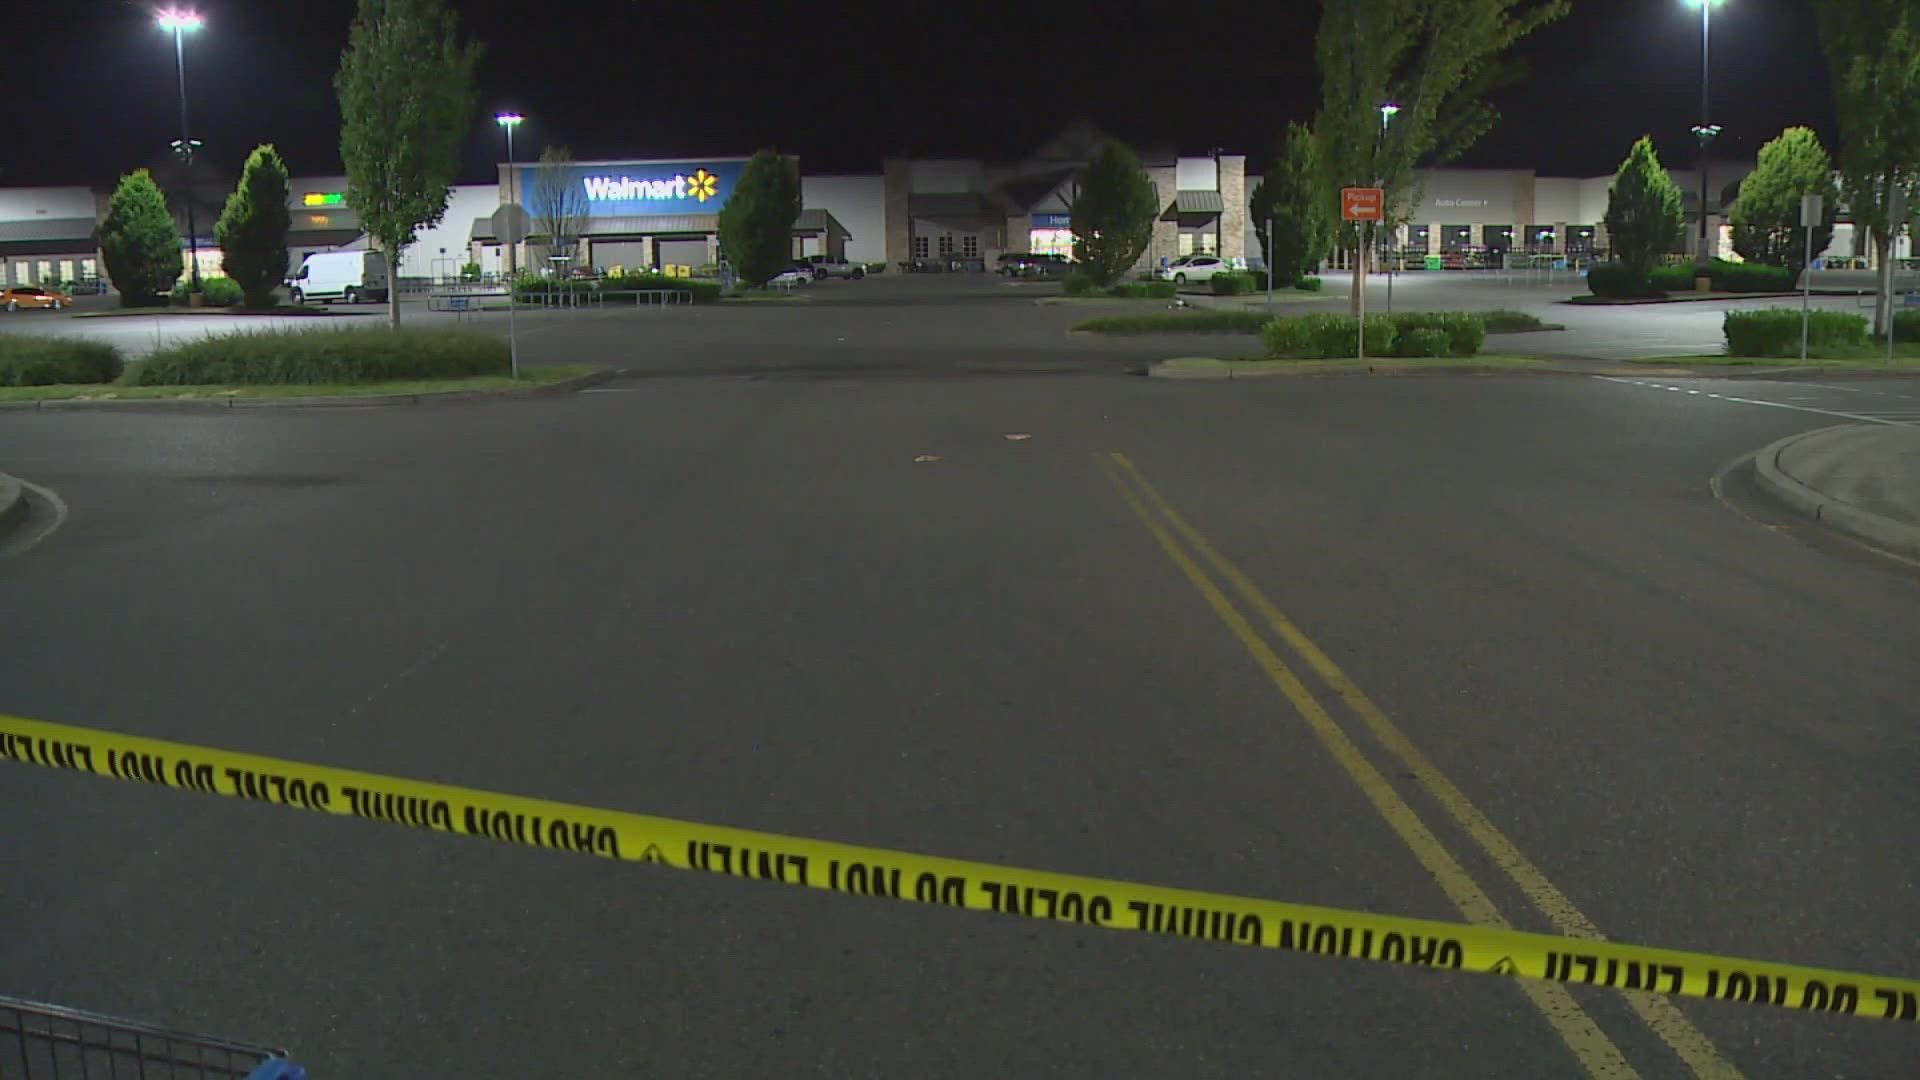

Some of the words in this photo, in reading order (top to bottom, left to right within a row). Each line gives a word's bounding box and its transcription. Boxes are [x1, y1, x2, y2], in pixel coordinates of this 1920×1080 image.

[583, 175, 687, 200] Walmart
[1347, 191, 1377, 204] Pickup
[1435, 198, 1455, 208] Auto
[1455, 198, 1481, 208] Center
